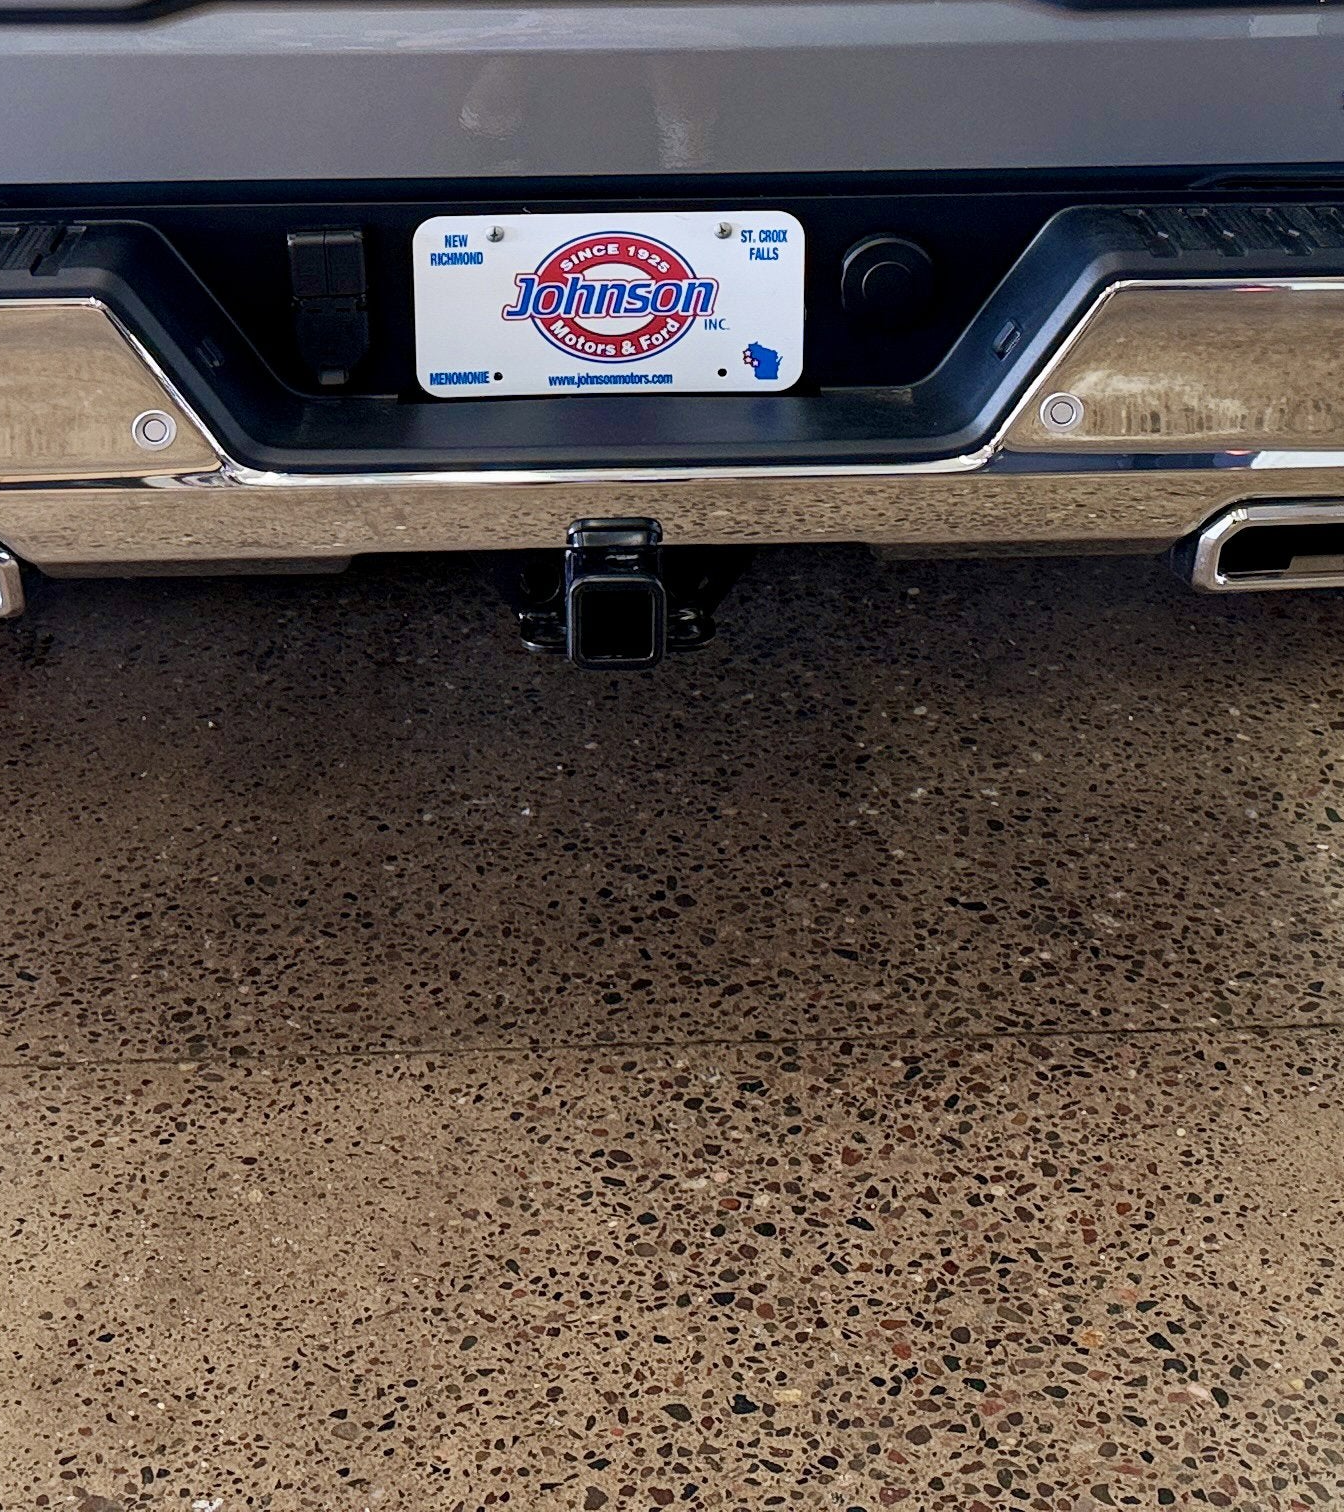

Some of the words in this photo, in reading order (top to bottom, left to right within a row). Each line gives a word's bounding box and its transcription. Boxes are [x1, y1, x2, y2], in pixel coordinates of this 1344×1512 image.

[444, 234, 468, 248] NEW
[740, 229, 756, 243] ST.
[759, 229, 788, 243] CROIX
[430, 251, 484, 266] RICHMOND
[560, 243, 619, 272] SINCE
[627, 245, 671, 274] 1925
[749, 247, 779, 260] FALLS
[503, 274, 718, 320] Johnson
[549, 319, 616, 356] Motors
[621, 340, 637, 356] &
[639, 317, 681, 351] Ford
[429, 371, 490, 386] MENOMONIE
[548, 372, 673, 388] www.johnsonmotors.com
